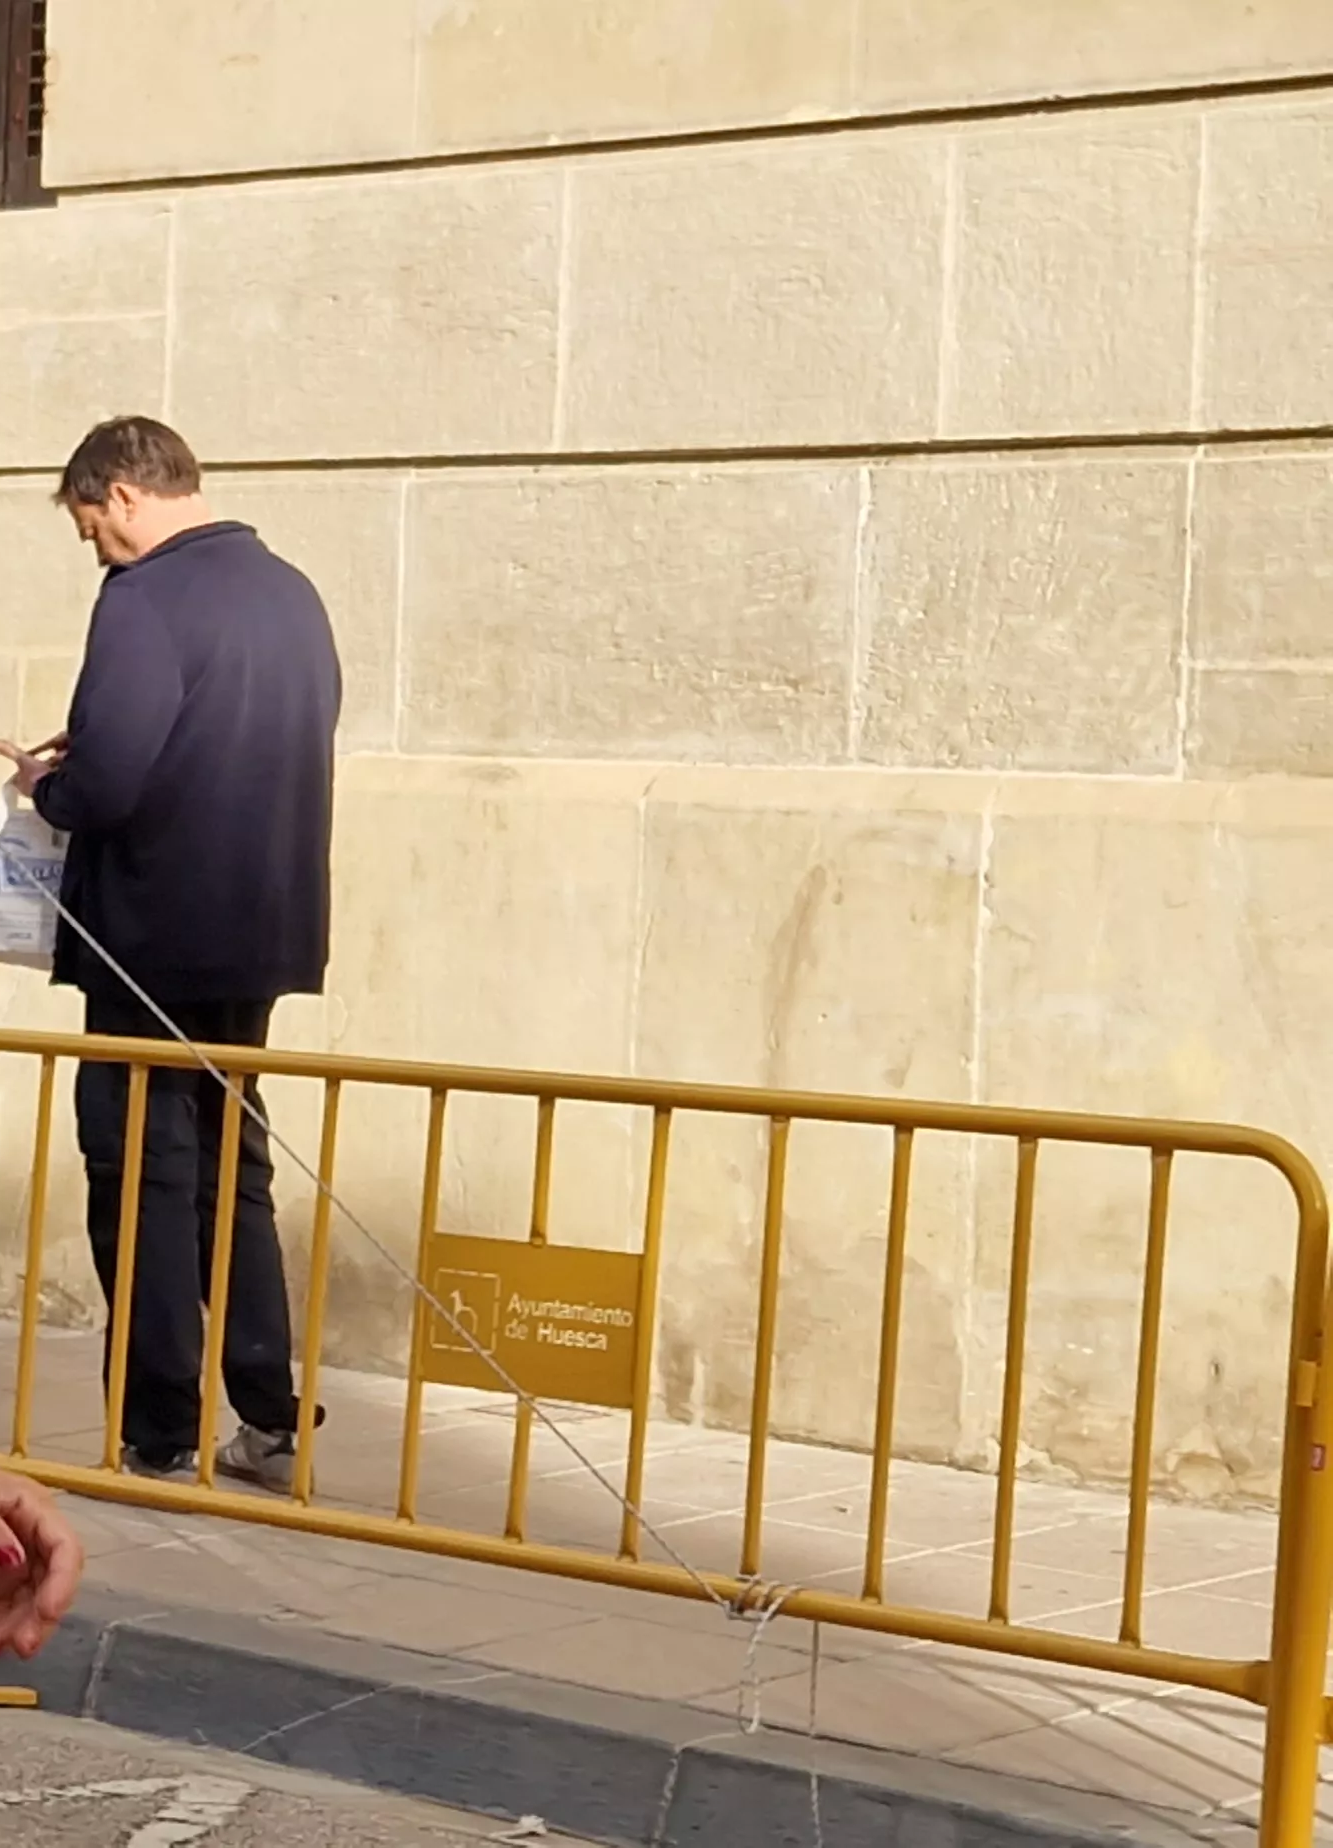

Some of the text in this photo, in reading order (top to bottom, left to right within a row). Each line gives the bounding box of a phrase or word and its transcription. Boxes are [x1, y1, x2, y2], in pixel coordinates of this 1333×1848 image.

[506, 1291, 634, 1328] Ayuntamiento
[504, 1318, 608, 1351] de Huesca
